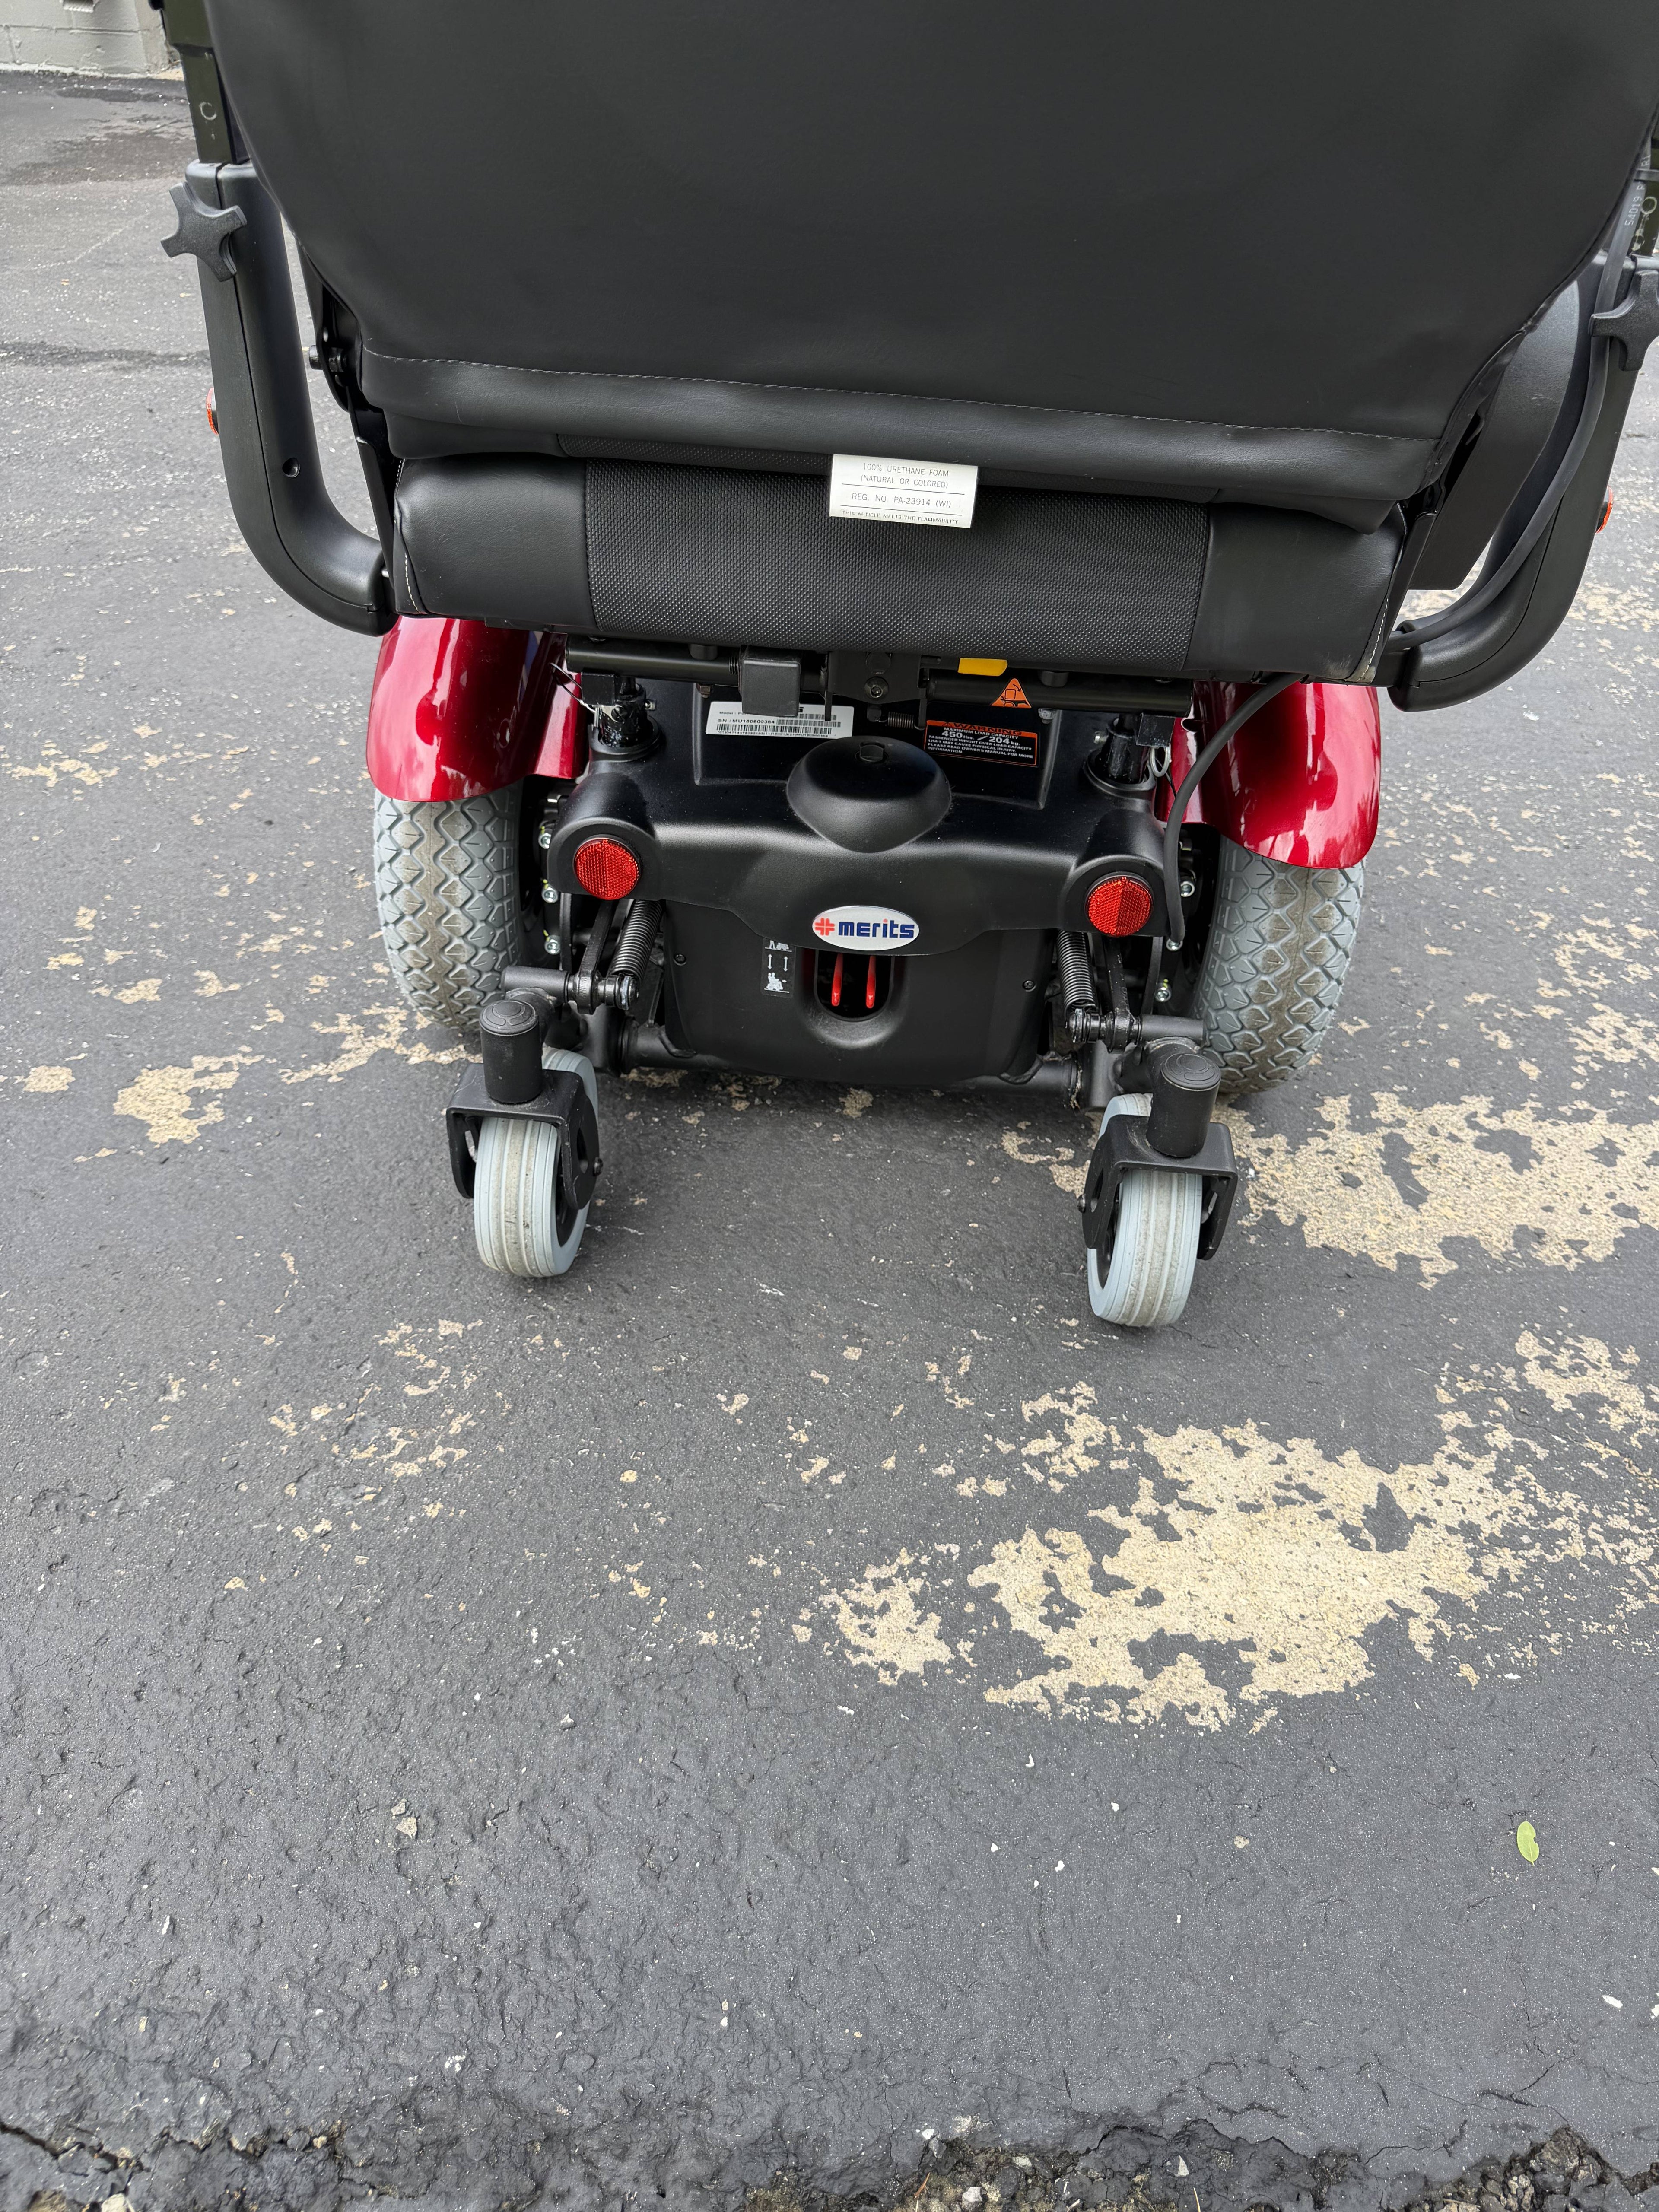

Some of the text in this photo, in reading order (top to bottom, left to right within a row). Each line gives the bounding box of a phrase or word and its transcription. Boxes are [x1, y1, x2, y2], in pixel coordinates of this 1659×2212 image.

[863, 463, 882, 471] 100%
[887, 465, 925, 475] URETHANE
[861, 474, 895, 484] (NATURAL
[914, 479, 948, 489] COLORED)
[852, 493, 869, 501] REG.
[894, 496, 930, 505] PA-23914
[936, 500, 951, 508] (WI)
[918, 516, 959, 524] FLAMMABILITY
[954, 723, 1022, 736] WARNING
[838, 918, 915, 939] merits
